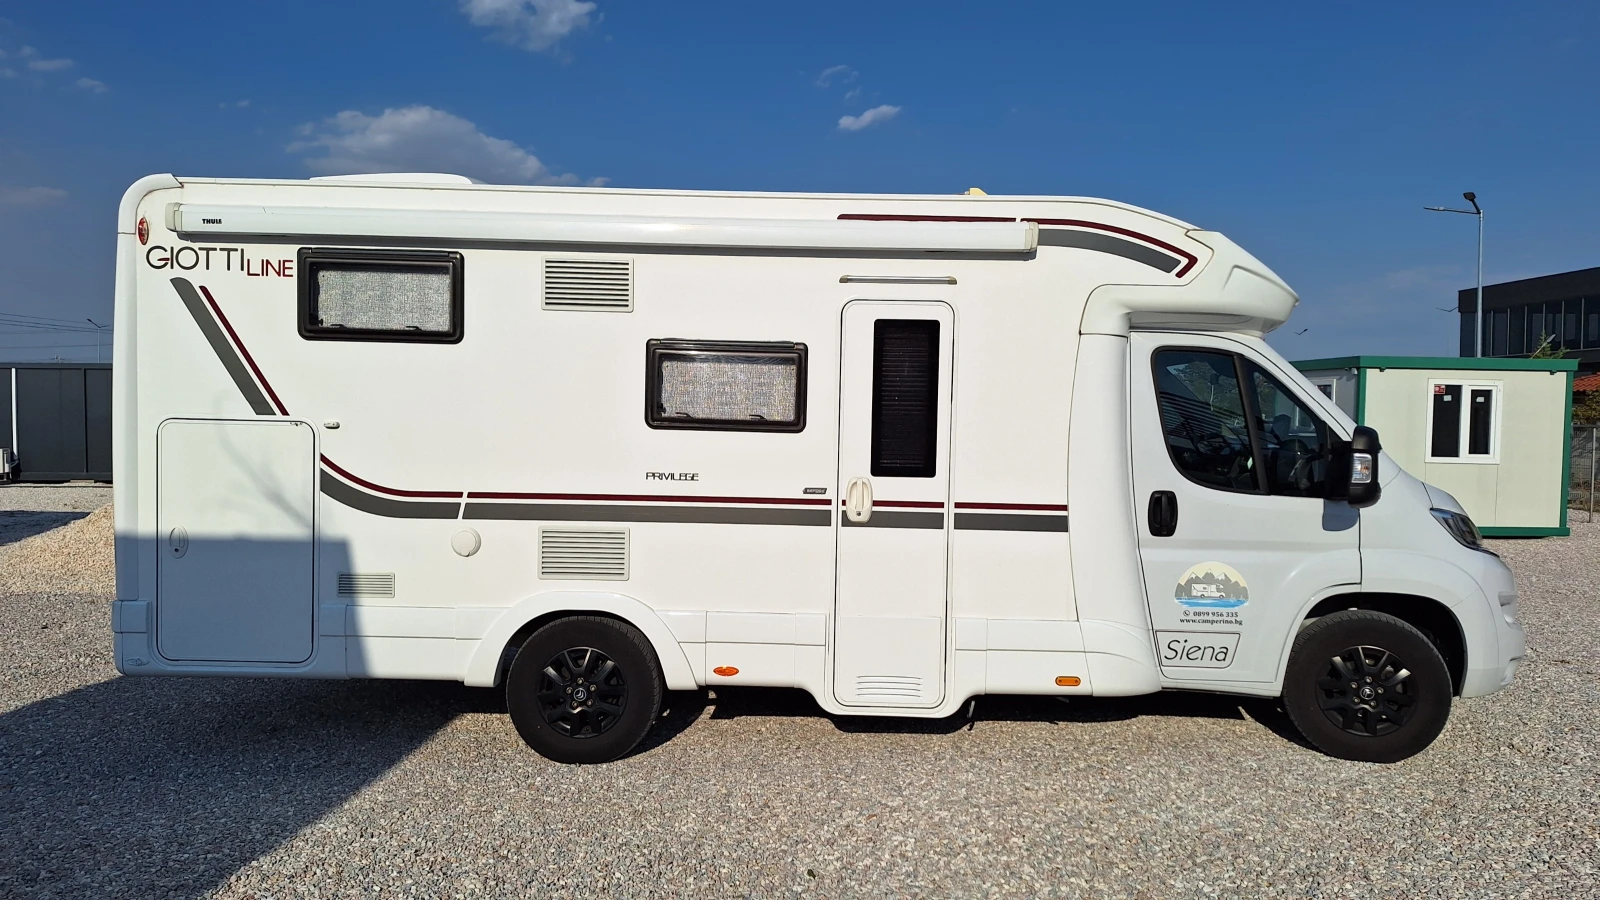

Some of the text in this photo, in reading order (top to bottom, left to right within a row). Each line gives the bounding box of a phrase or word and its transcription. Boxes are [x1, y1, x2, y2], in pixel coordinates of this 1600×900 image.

[645, 471, 699, 481] PRIVILEGE
[1179, 618, 1243, 626] www.camperino.bg
[1164, 639, 1229, 662] Siena
